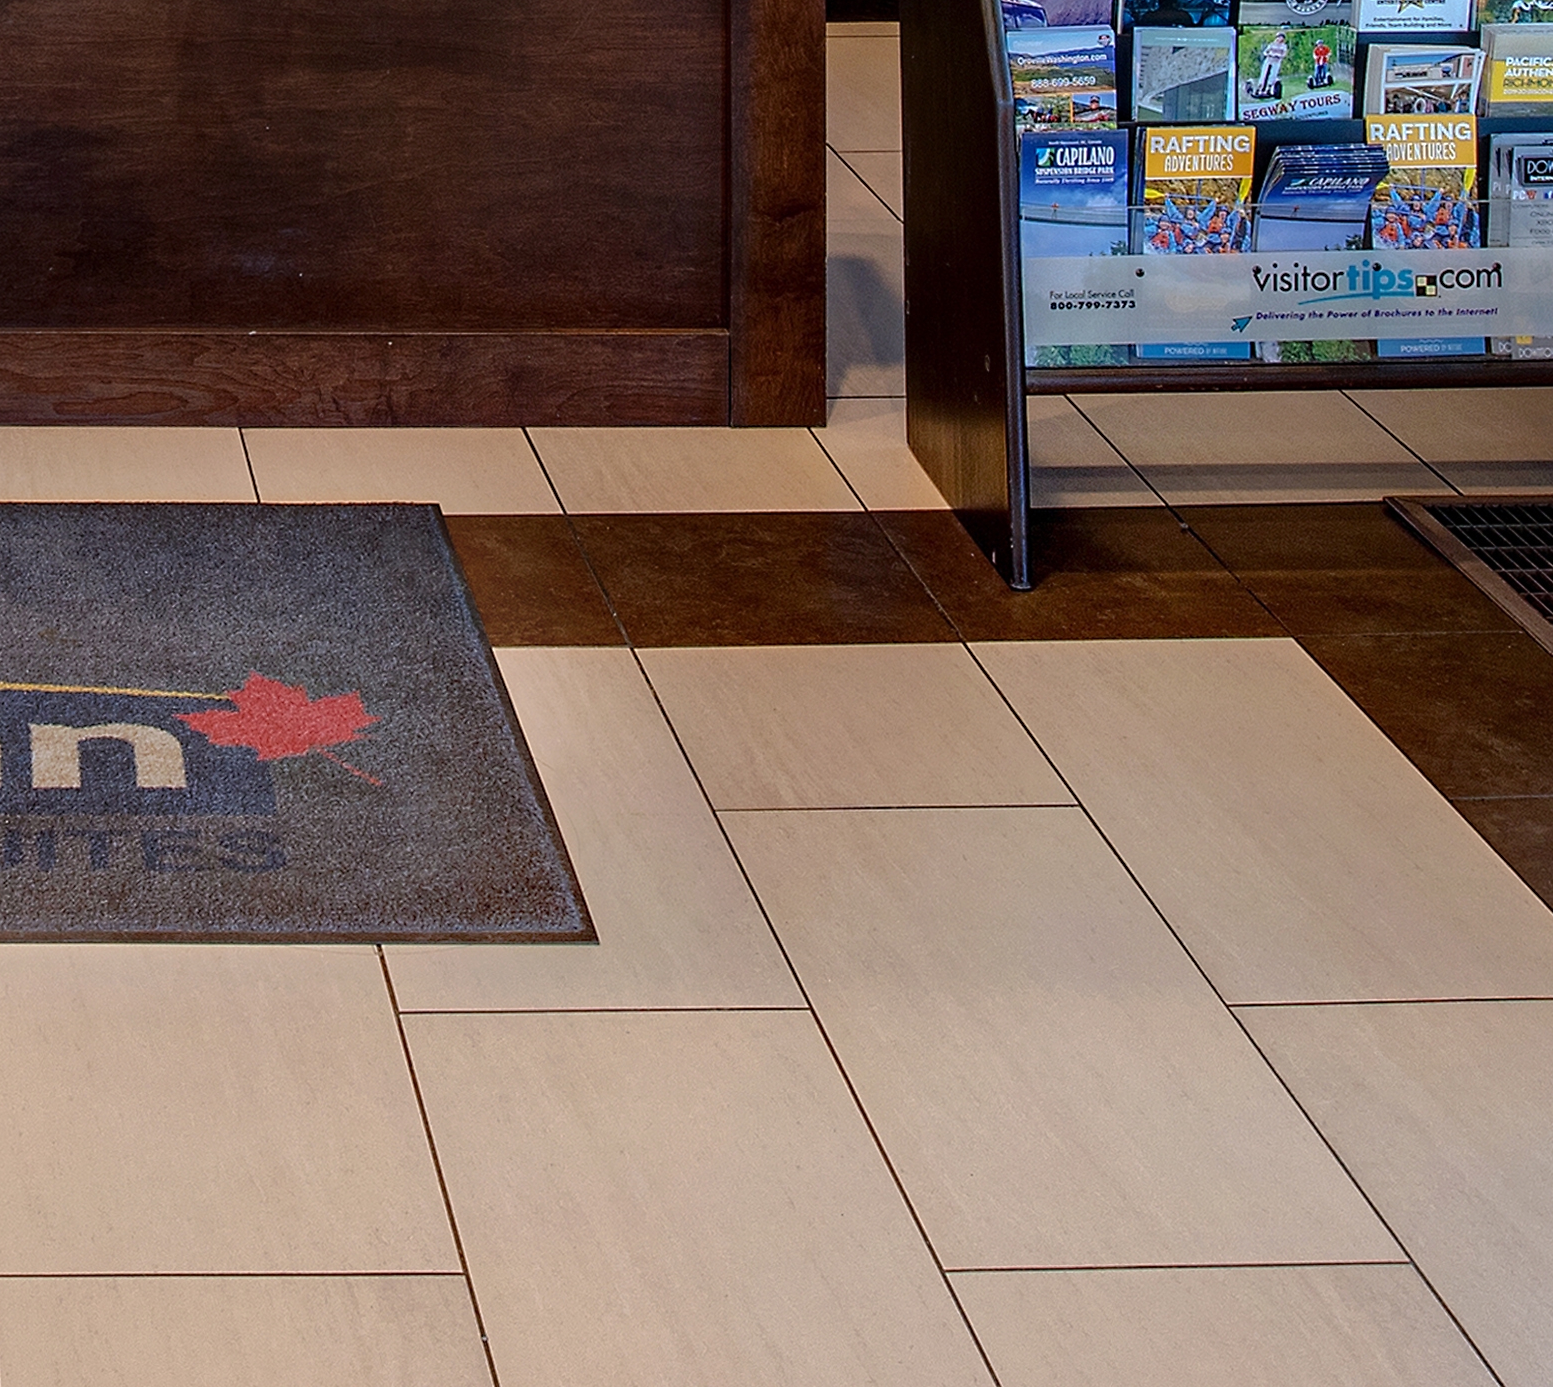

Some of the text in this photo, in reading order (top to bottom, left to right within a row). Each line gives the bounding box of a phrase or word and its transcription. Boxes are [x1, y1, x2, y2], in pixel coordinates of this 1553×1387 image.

[1031, 77, 1096, 88] 888-699-5659
[1243, 94, 1341, 120] SEGWAY TOURS
[1369, 122, 1472, 141] RAFTING
[1150, 135, 1250, 154] RAFTING
[1386, 142, 1456, 161] ADVENTURES
[1056, 146, 1114, 166] CAPILANO
[1164, 154, 1233, 172] ADVENTURES
[1308, 177, 1370, 185] CAPILANO
[1513, 190, 1527, 200] PC
[1253, 259, 1503, 300] visitortips.com
[1065, 290, 1085, 299] Local
[1087, 290, 1116, 298] Service
[1118, 289, 1134, 298] Call
[1050, 301, 1136, 310] 800-799-7373
[1256, 310, 1305, 320] Delivering
[1308, 310, 1324, 318] the
[1327, 310, 1358, 318] Power
[1361, 309, 1372, 318] of
[1374, 309, 1422, 317] Brochures
[1438, 308, 1453, 316] the
[1456, 308, 1498, 316] Internet!
